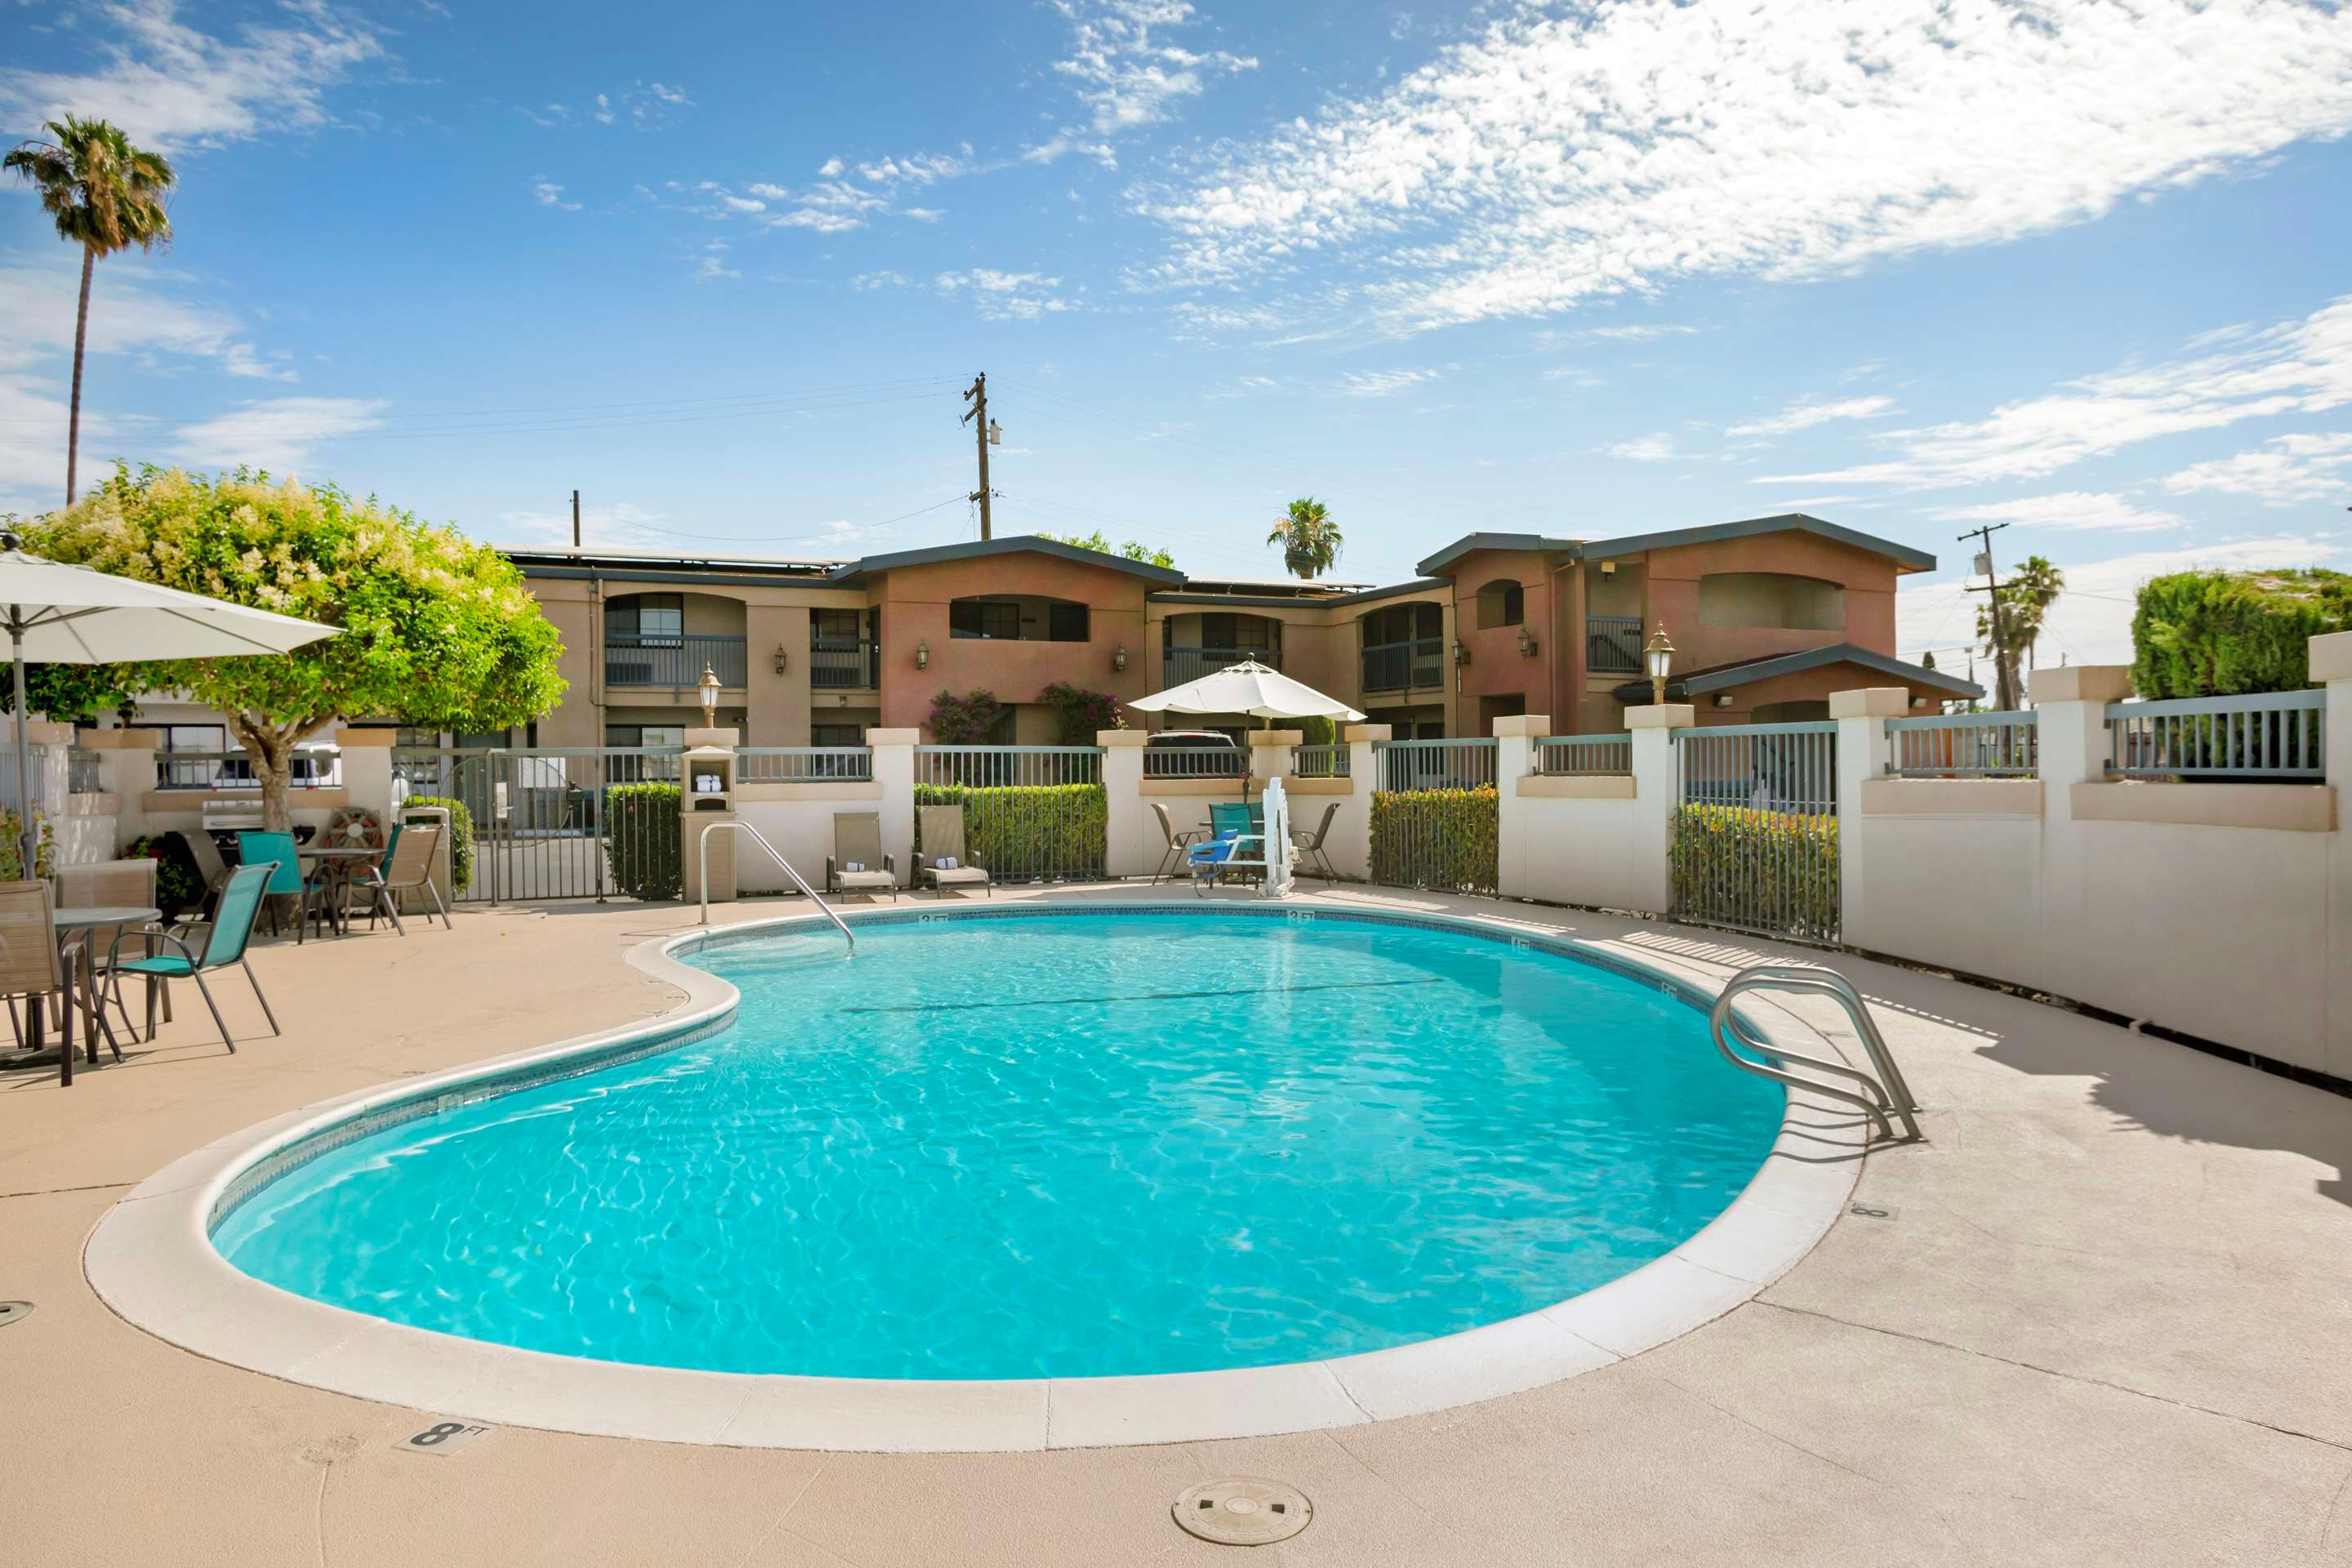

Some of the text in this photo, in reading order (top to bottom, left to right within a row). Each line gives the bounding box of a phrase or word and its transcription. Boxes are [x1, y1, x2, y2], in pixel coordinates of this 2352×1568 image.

[1851, 1208, 1889, 1218] 8
[410, 1423, 491, 1446] 8 FT
